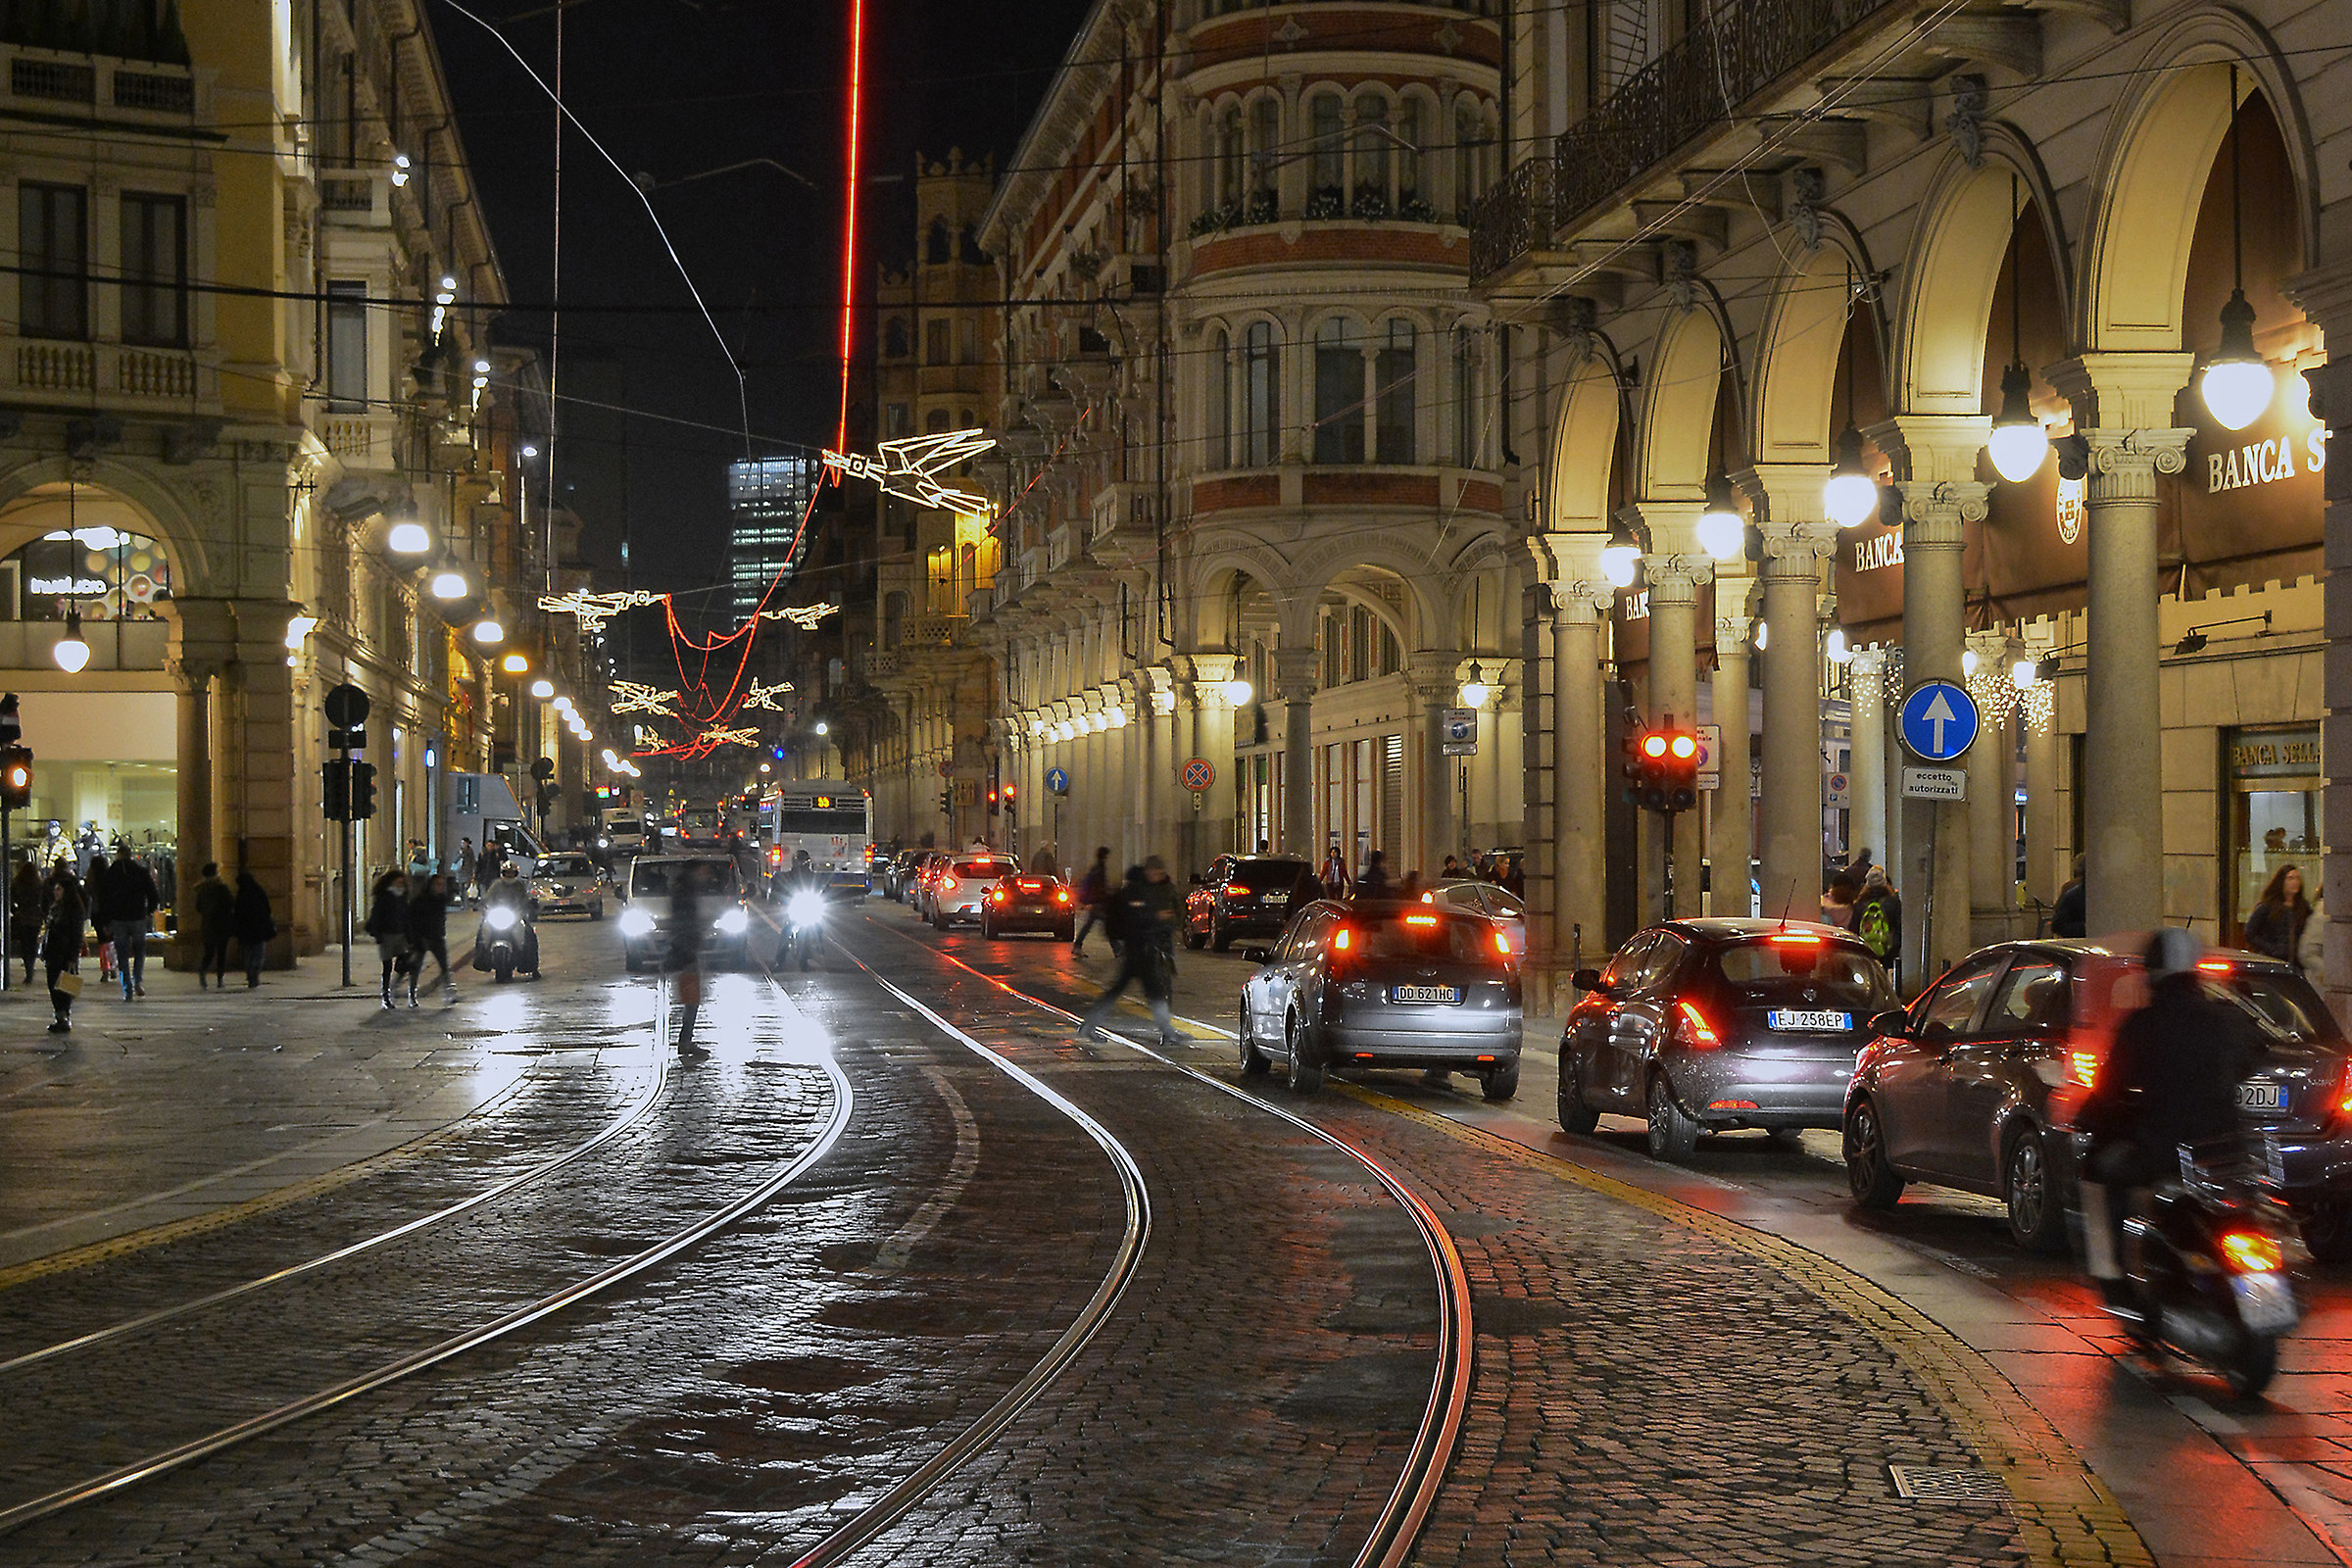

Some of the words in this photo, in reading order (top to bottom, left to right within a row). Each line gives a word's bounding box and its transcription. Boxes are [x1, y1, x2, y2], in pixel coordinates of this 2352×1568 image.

[2208, 435, 2295, 494] BANCA
[1855, 531, 1905, 572] BANCA
[2233, 745, 2278, 766] BANCA
[1909, 785, 1958, 795] autorizzati
